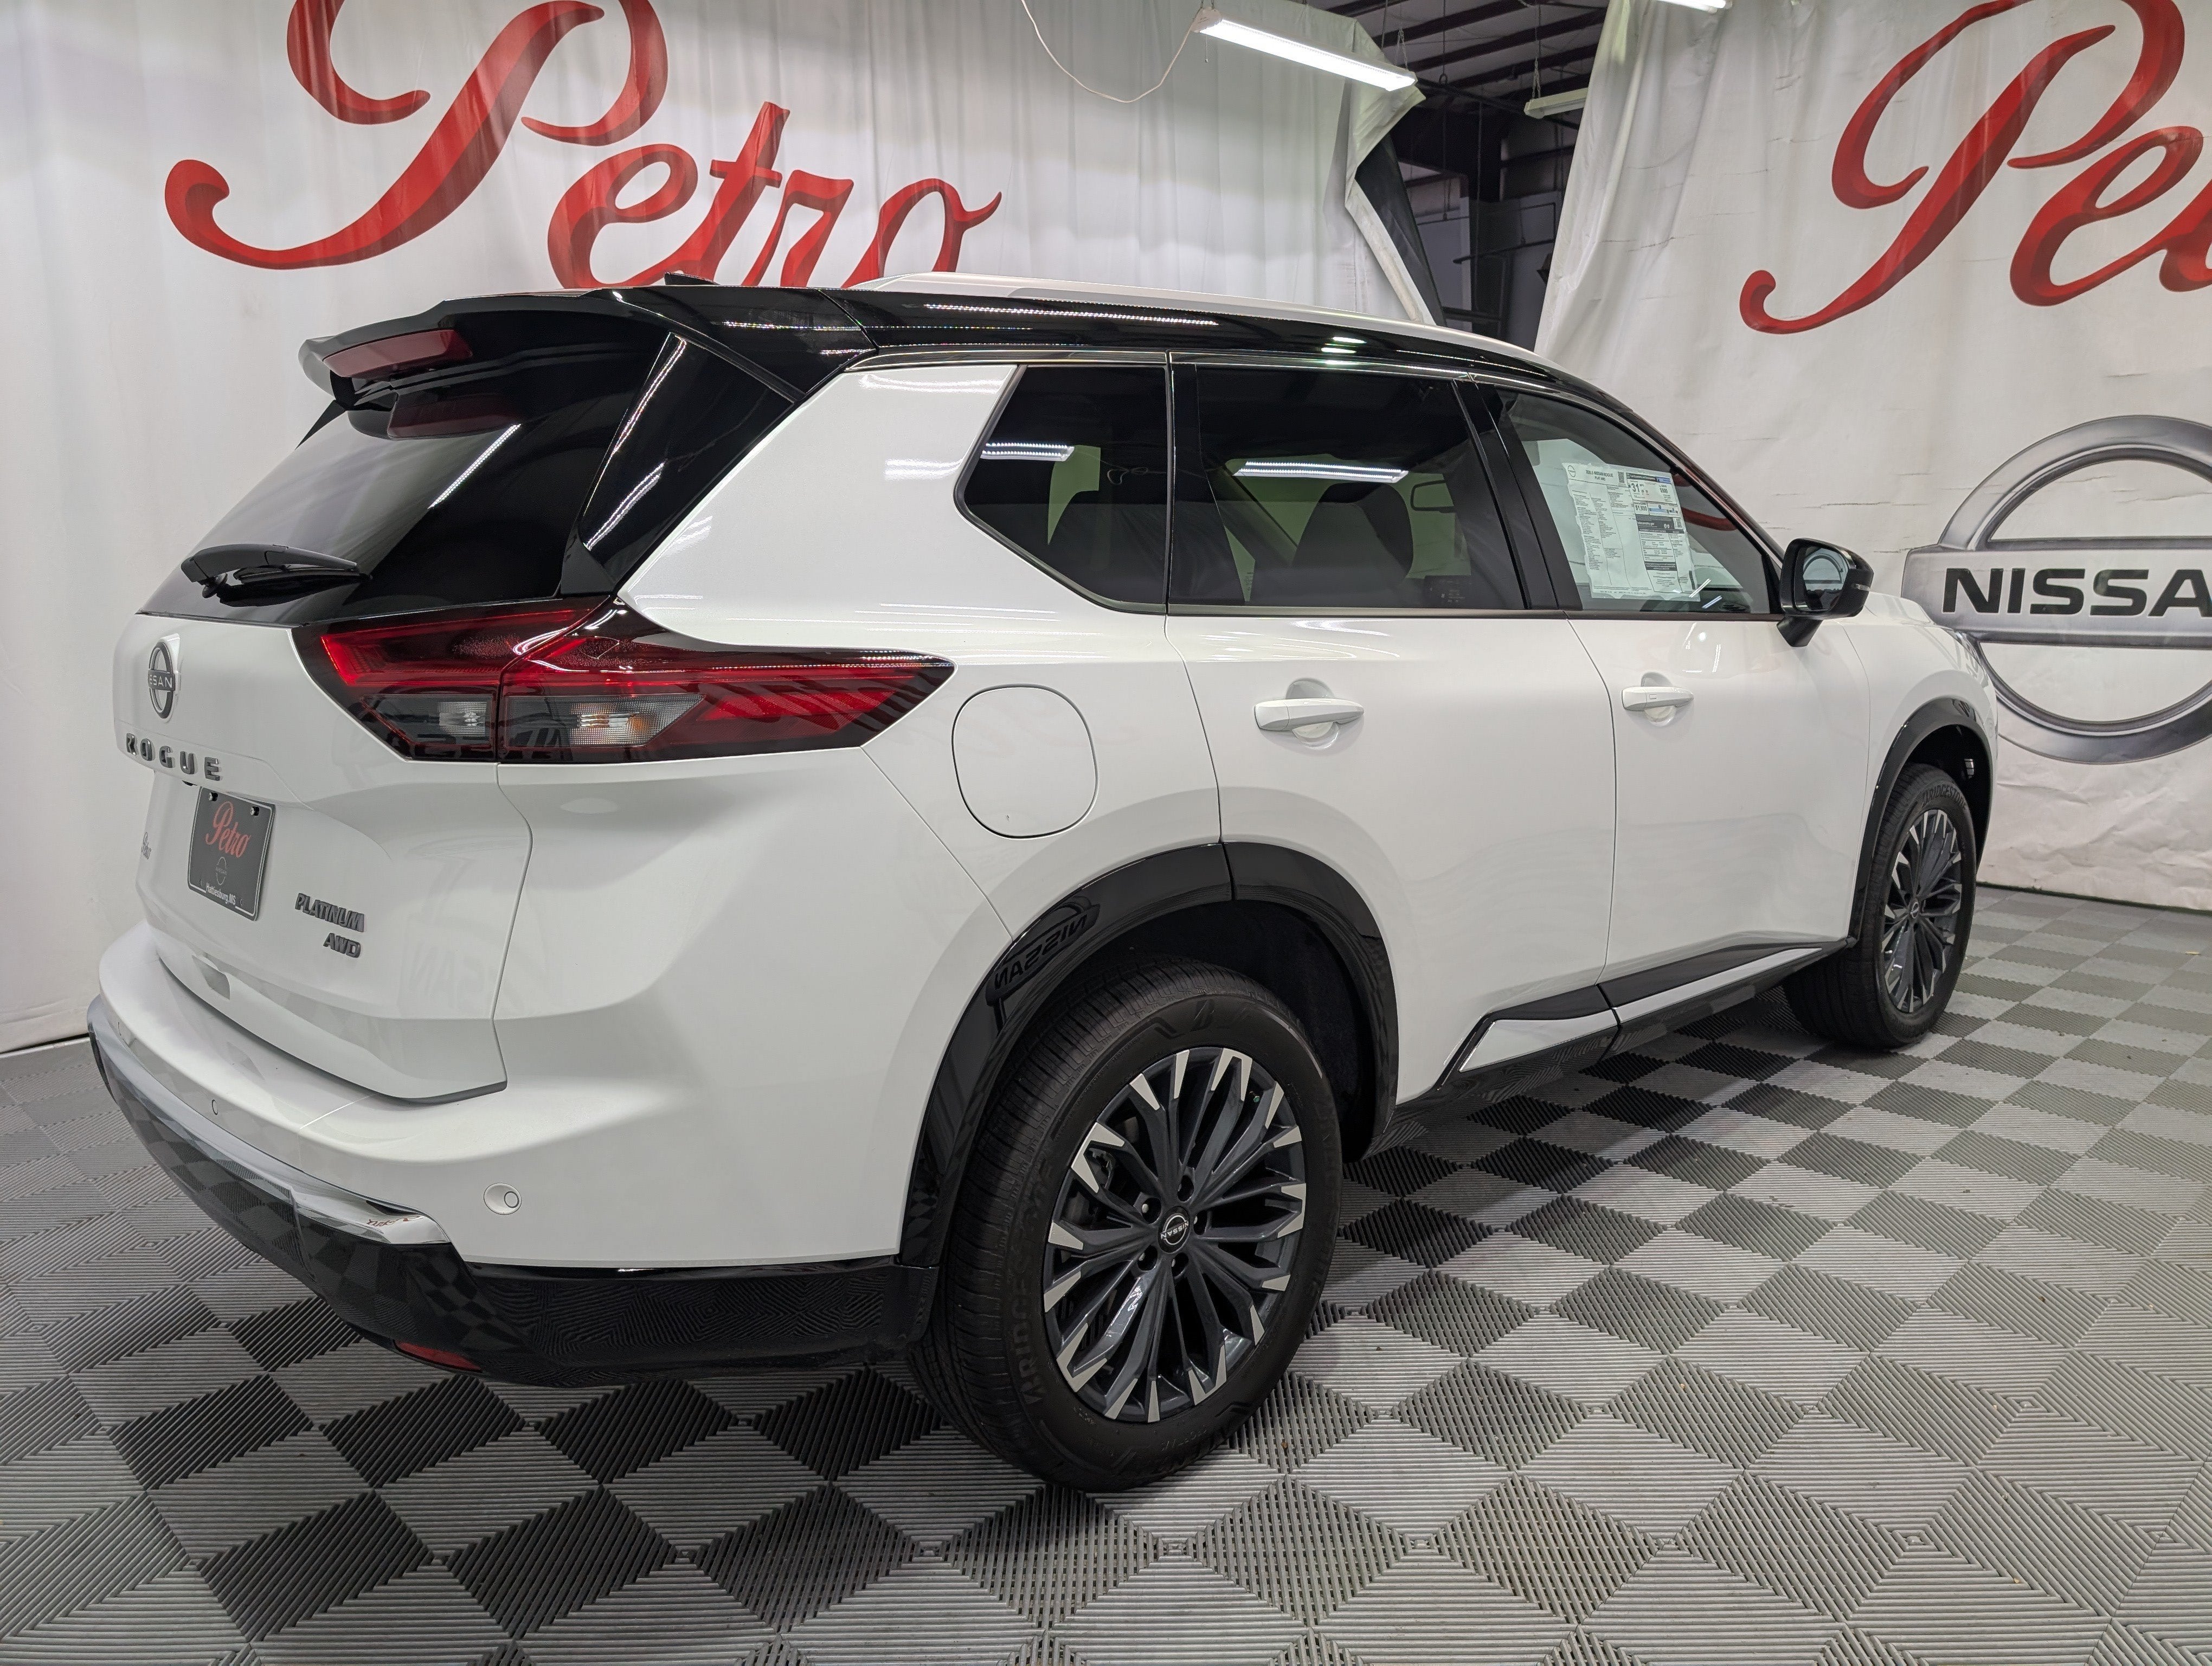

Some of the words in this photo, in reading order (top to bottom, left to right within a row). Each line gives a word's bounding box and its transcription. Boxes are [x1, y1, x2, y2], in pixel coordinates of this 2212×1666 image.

[164, 0, 1002, 289] Petro
[1631, 483, 1640, 492] 31
[126, 733, 221, 781] ROGUE
[205, 801, 252, 858] Petro
[295, 893, 364, 932] PLATINUM
[323, 933, 361, 958] AWD
[1161, 1220, 1189, 1240] NISSAN
